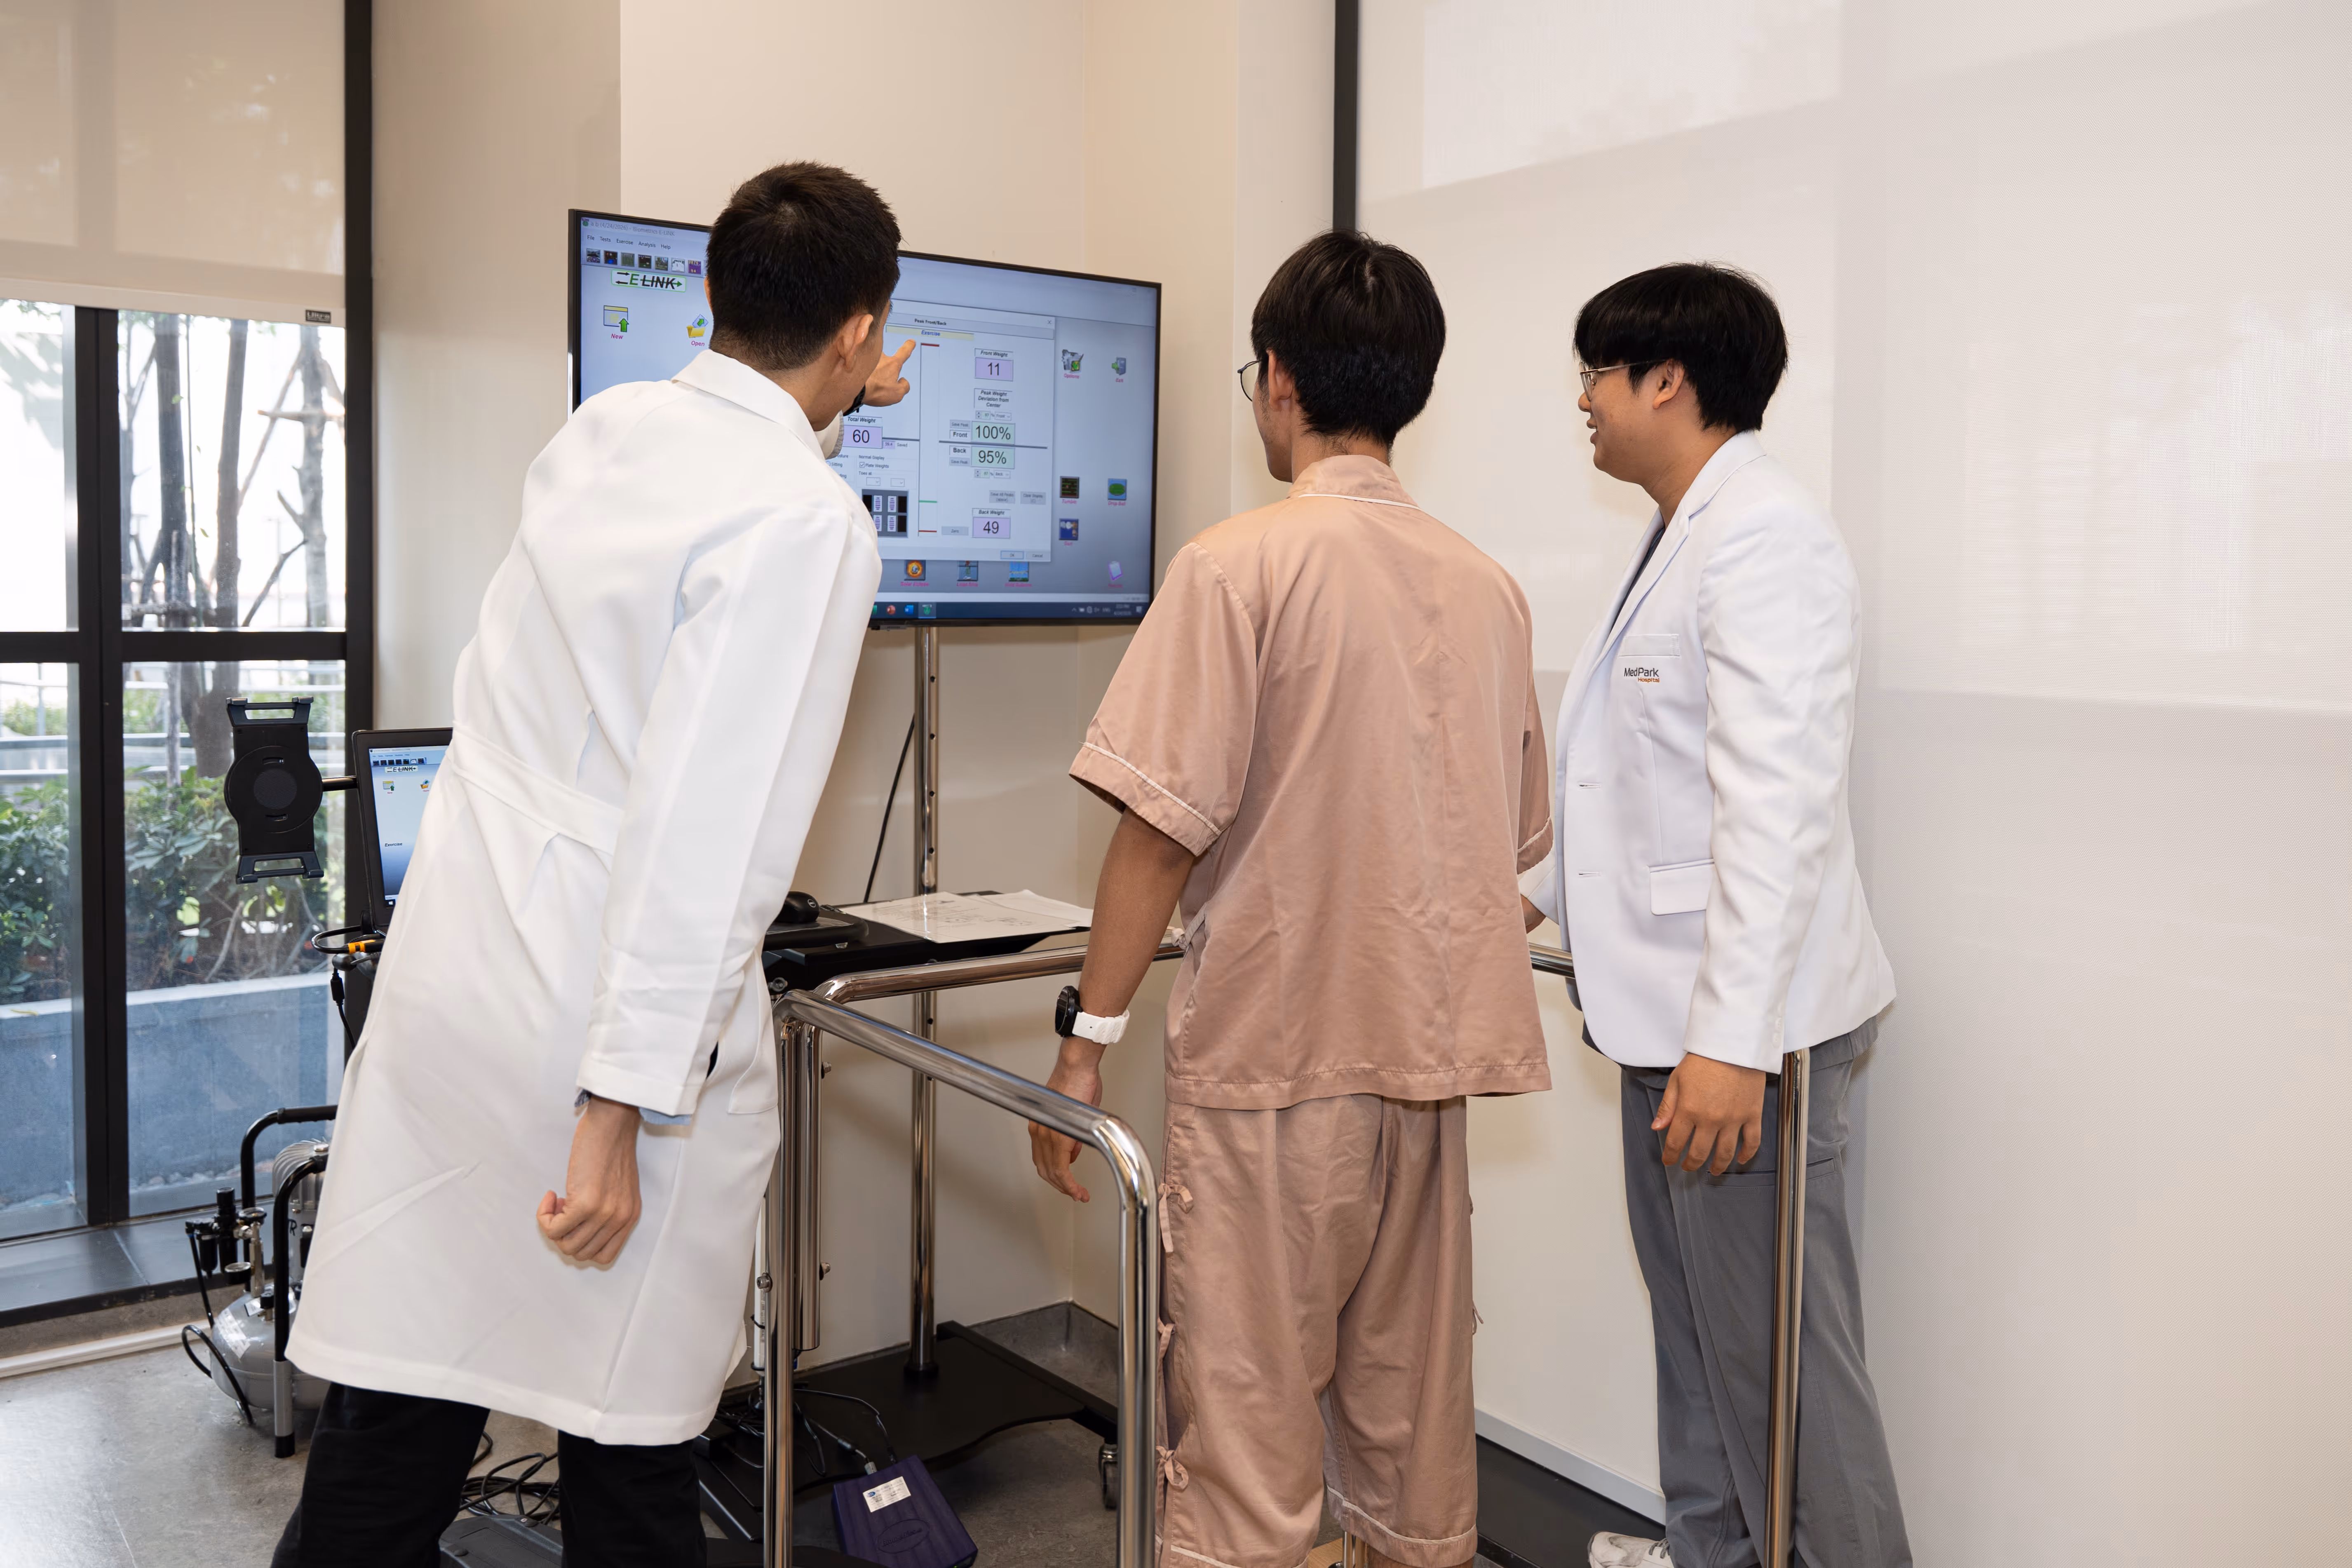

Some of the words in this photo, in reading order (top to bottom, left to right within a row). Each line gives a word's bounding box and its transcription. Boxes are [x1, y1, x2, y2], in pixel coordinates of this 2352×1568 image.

[988, 362, 1000, 376] 11
[853, 430, 869, 443] 60
[976, 425, 1011, 440] 100%
[978, 450, 1007, 464] 95%
[983, 521, 999, 534] 49
[1624, 667, 1659, 677] MedPark
